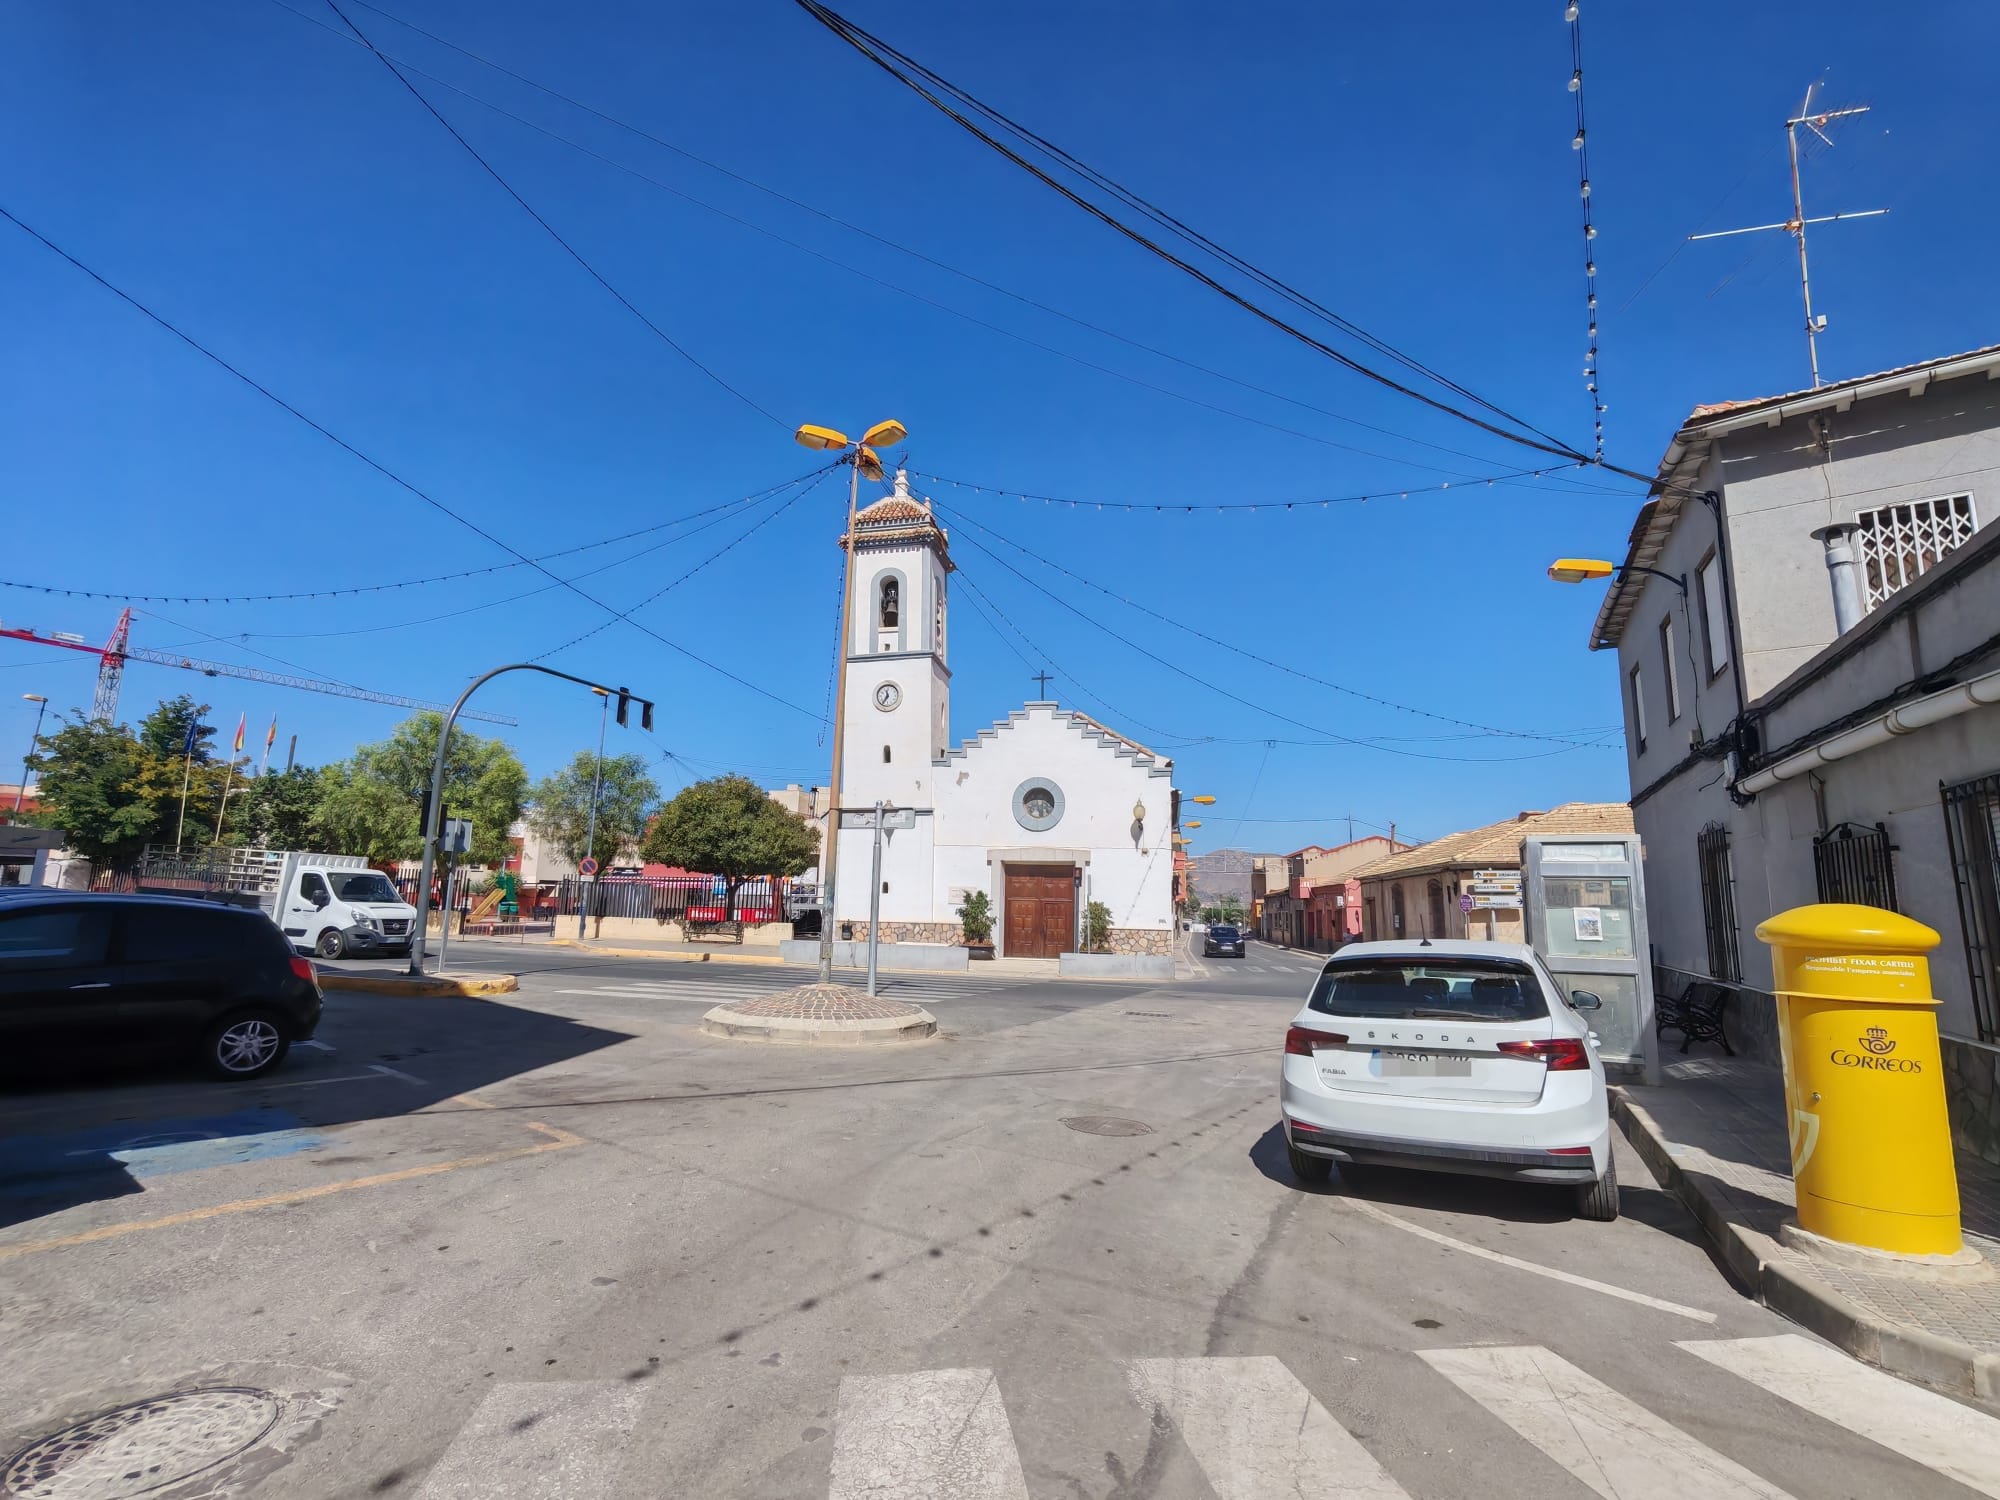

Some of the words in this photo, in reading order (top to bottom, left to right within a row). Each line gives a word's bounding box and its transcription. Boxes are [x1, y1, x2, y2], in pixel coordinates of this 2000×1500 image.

[1850, 958, 1877, 967] FIXAR
[1880, 960, 1914, 968] CARTELLS
[1367, 1031, 1475, 1043] SKODA
[1830, 1049, 1922, 1074] CORREOS
[1321, 1067, 1347, 1076] FABIA
